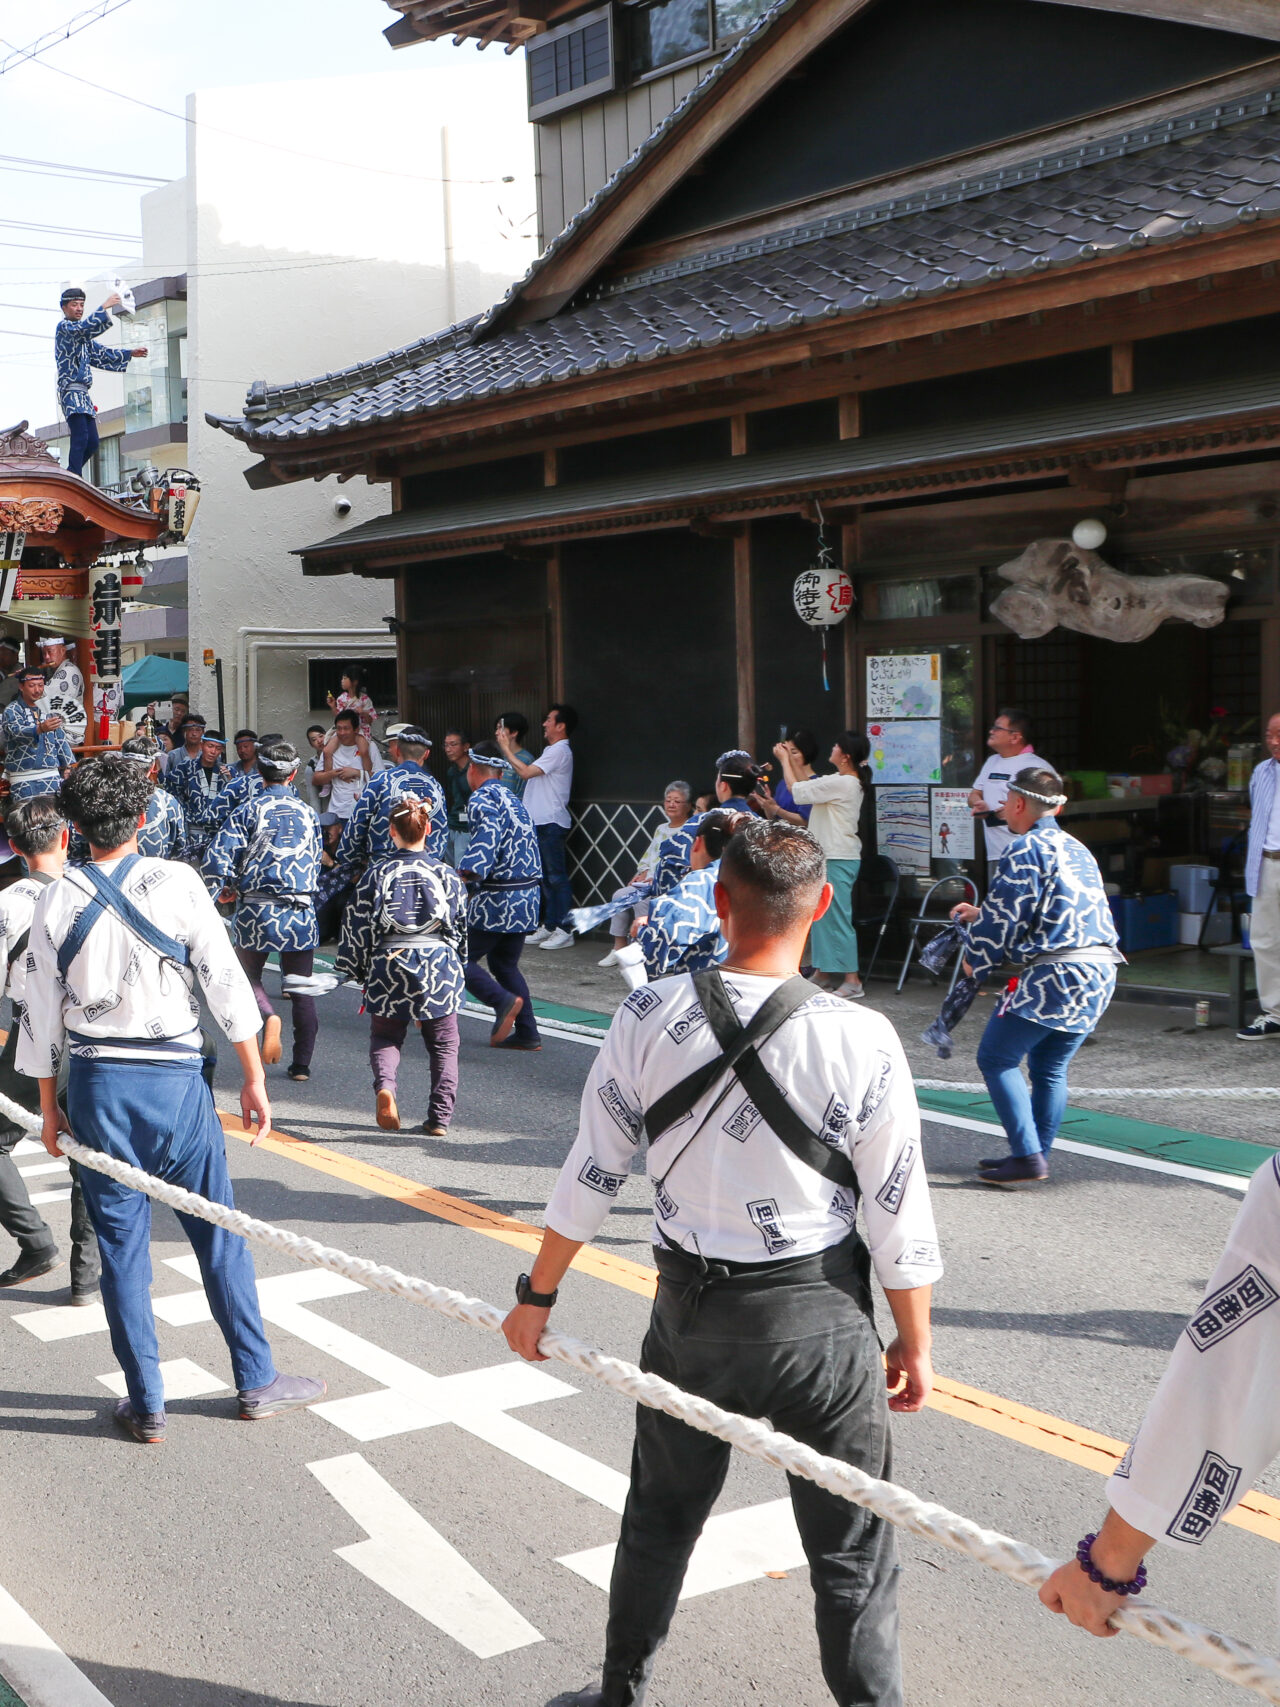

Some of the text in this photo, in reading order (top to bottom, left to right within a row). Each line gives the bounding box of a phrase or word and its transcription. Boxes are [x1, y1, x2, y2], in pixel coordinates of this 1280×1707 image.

[795, 572, 824, 622] 御待夜
[1180, 1461, 1231, 1539] 四番町
